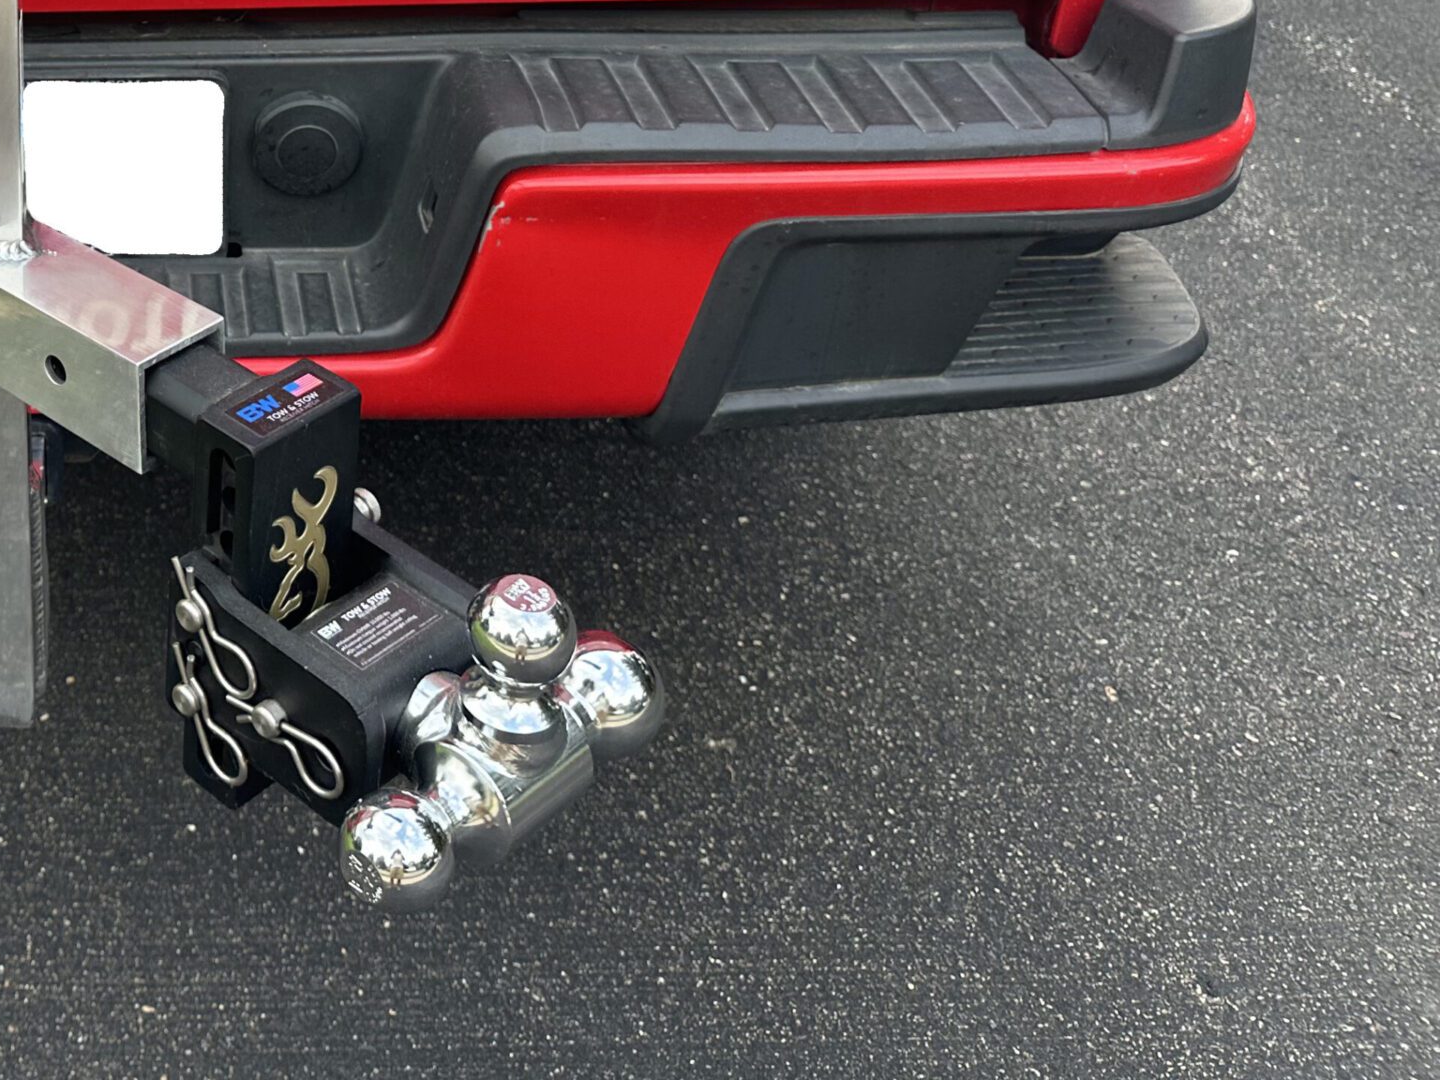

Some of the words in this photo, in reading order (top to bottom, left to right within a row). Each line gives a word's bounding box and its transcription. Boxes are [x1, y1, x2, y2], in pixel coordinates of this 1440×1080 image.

[266, 407, 288, 422] TOW
[293, 391, 320, 408] STOW
[340, 604, 362, 622] TOW
[367, 587, 392, 607] STOW
